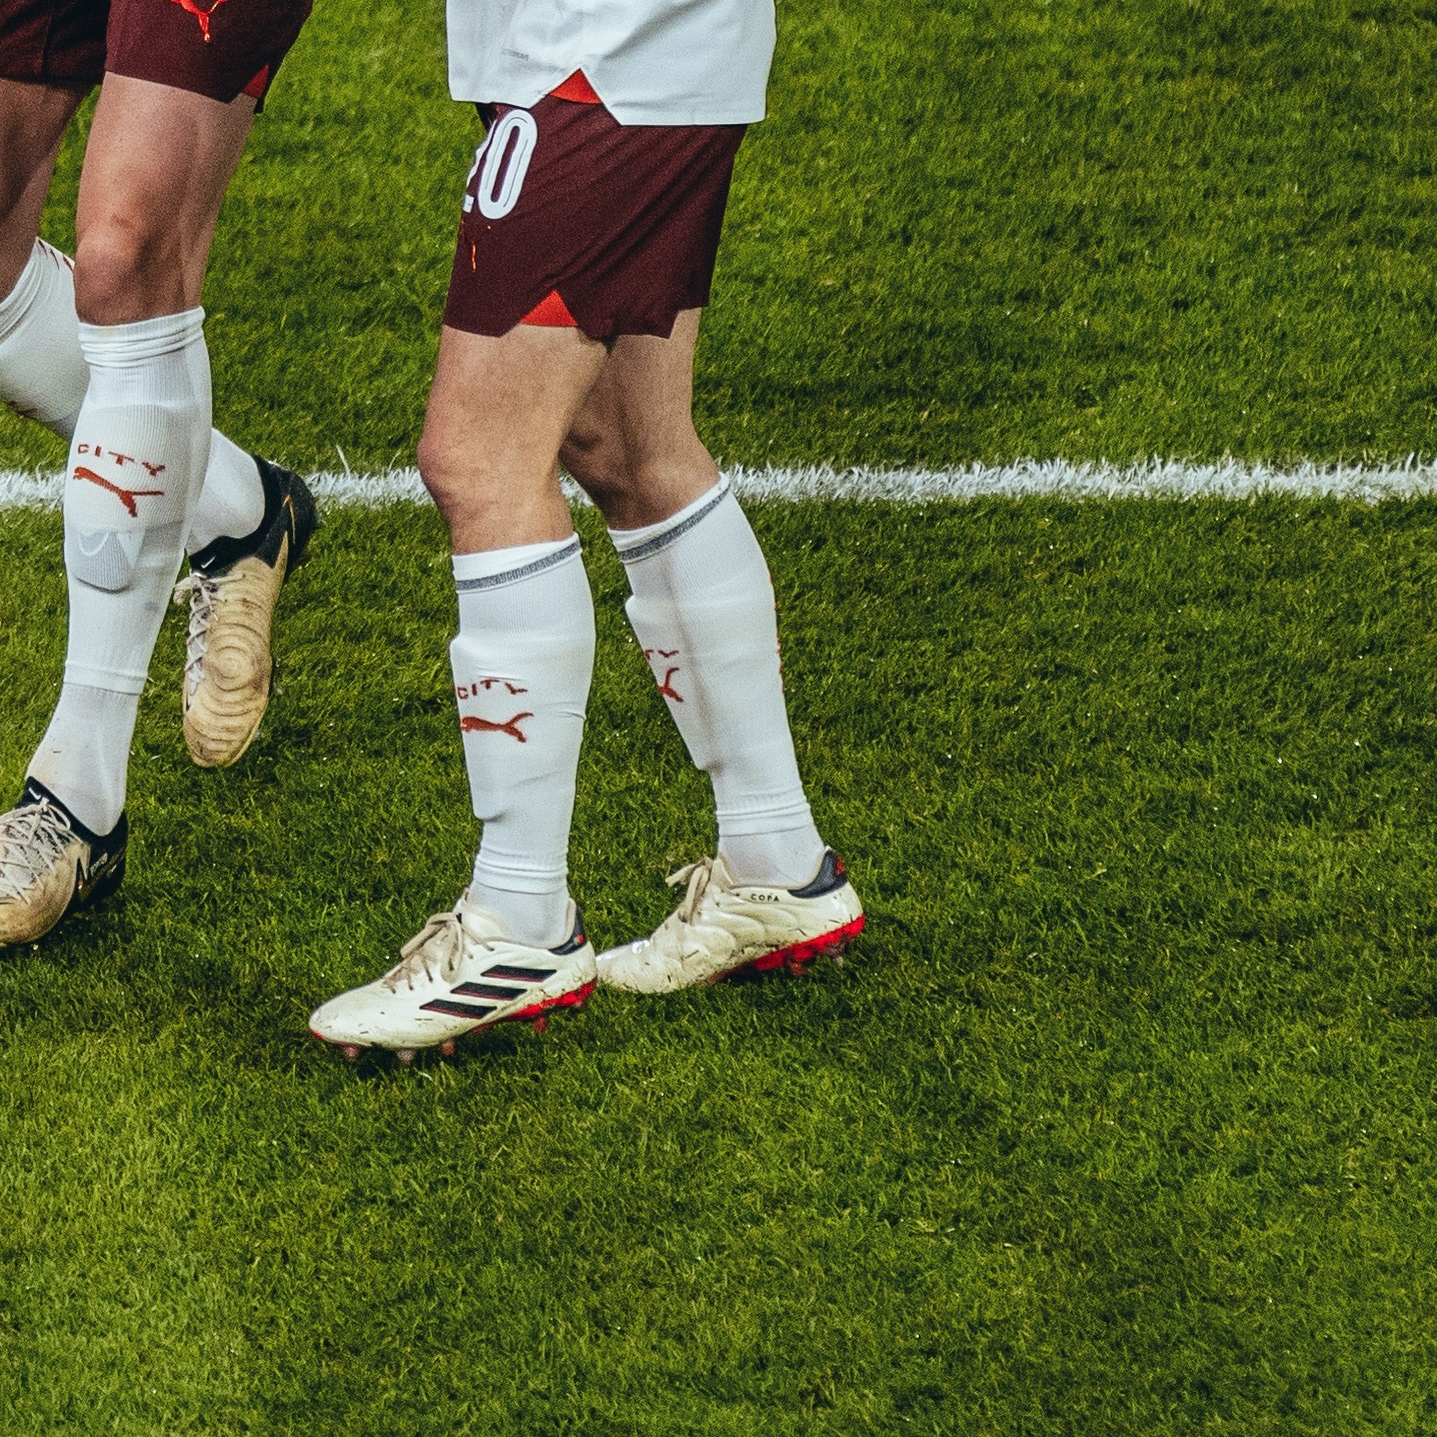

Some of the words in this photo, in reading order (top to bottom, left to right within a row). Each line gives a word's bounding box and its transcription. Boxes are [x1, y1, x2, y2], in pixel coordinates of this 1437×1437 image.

[77, 443, 166, 477] CITY
[457, 679, 528, 700] CITY
[750, 893, 780, 903] COPA
